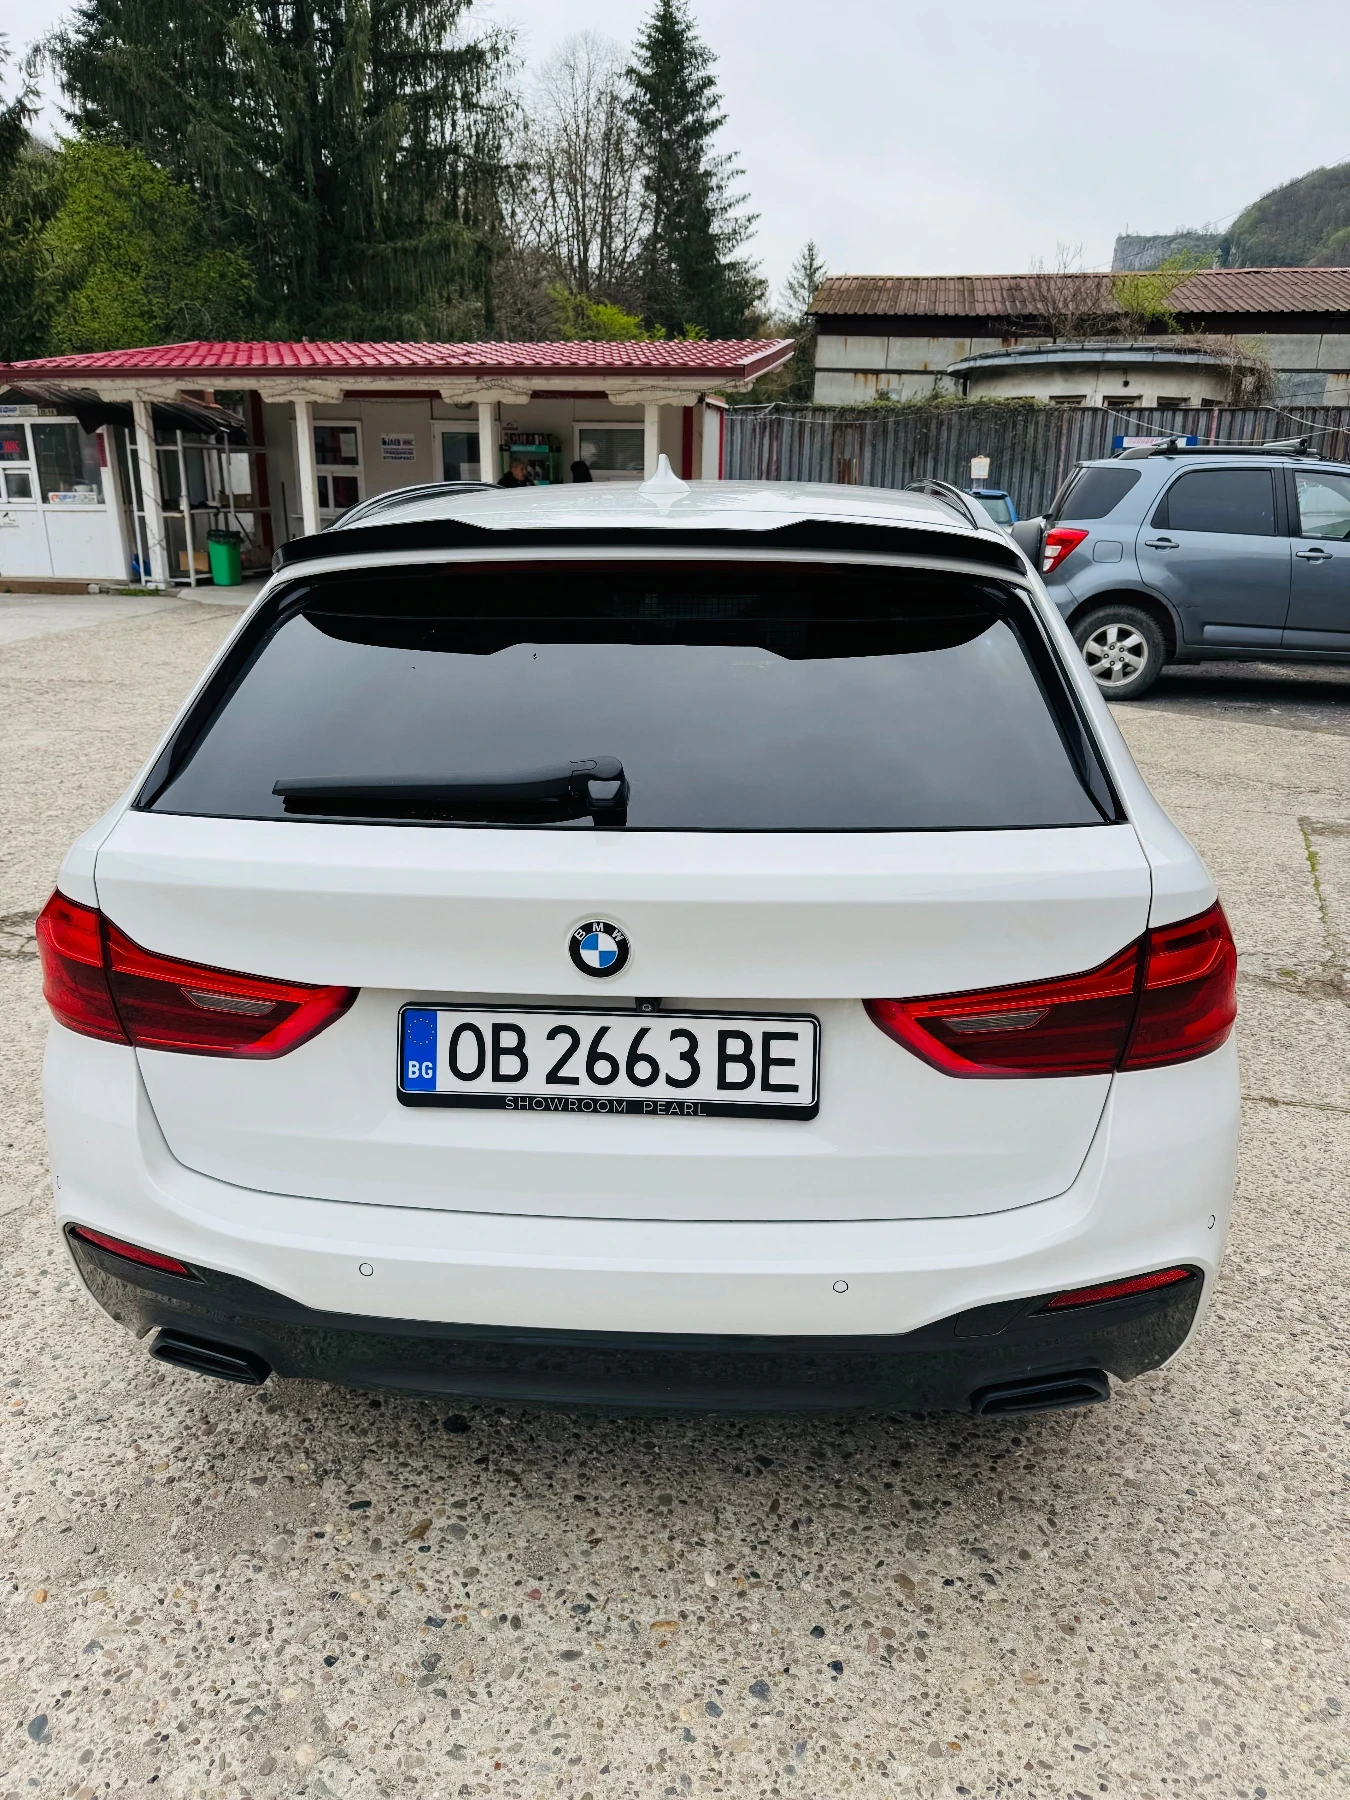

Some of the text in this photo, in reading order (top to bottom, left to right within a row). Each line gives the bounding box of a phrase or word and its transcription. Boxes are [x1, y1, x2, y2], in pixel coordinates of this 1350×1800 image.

[574, 922, 625, 942] BMW
[545, 1024, 701, 1089] 2663
[716, 1029, 801, 1094] BE
[408, 1060, 434, 1080] BG
[505, 1096, 707, 1116] SHOWROOM PEARL
